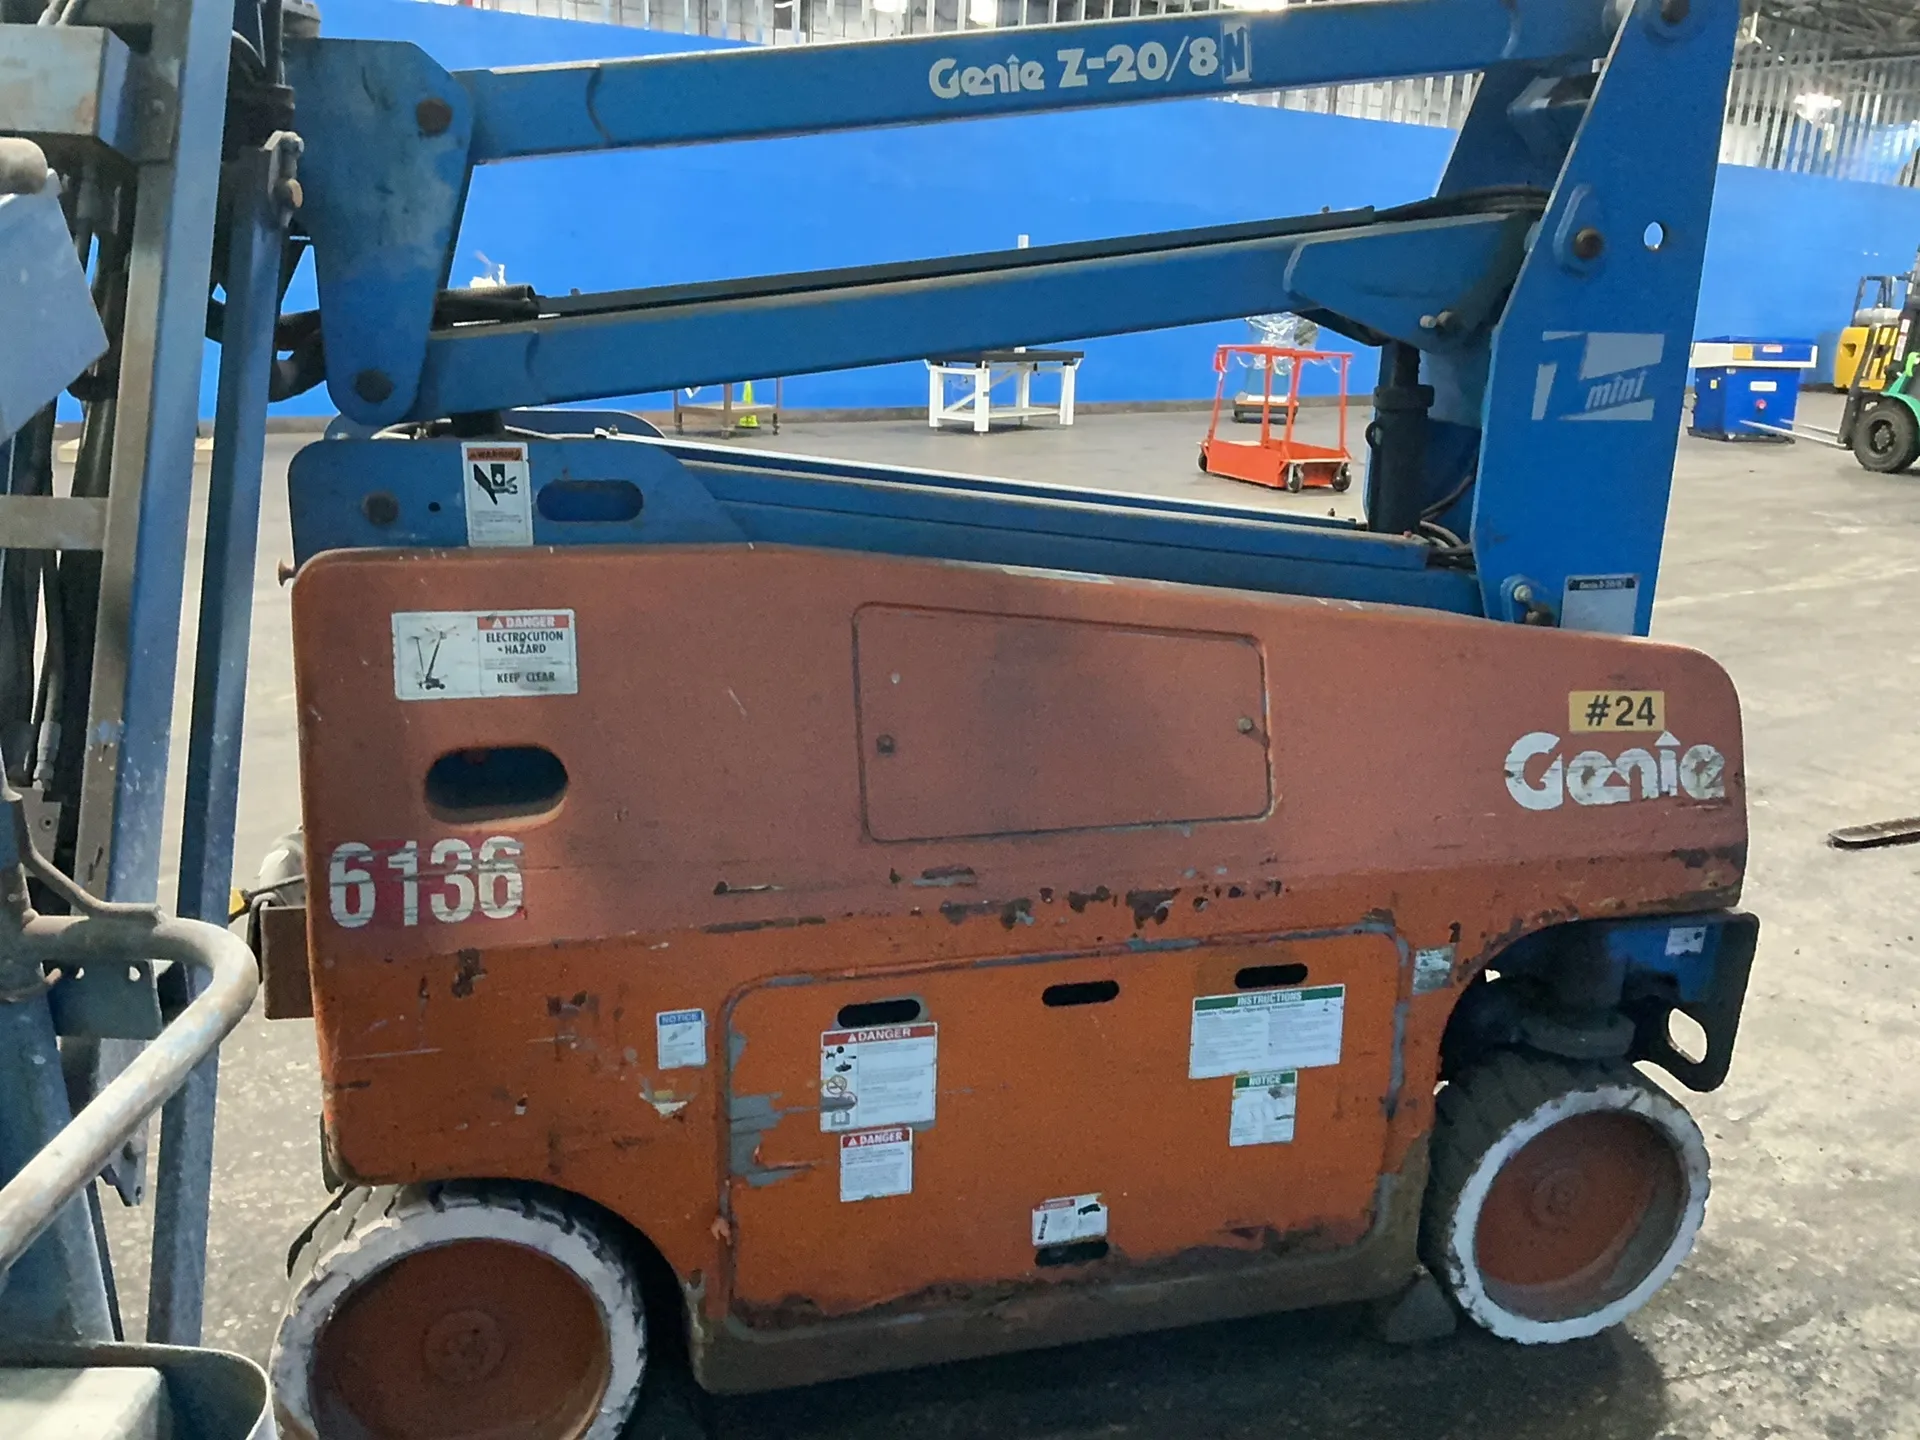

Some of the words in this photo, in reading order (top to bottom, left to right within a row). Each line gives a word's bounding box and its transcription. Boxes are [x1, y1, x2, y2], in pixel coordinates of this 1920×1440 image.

[929, 54, 1045, 99] Genie
[1585, 370, 1648, 410] mini
[506, 616, 555, 628] DANGER
[486, 631, 563, 643] ELECTROCUTION
[504, 643, 547, 654] HAZARD
[497, 672, 520, 683] KEEP
[526, 671, 556, 682] CLEAR
[1585, 694, 1656, 726] #24
[1504, 730, 1725, 810] Genie
[329, 836, 524, 928] 6136
[1237, 991, 1302, 1006] INSTRUCTIONS
[662, 1013, 699, 1025] NOTICE
[858, 1027, 912, 1042] DANGER
[1249, 1074, 1281, 1086] NOTICE
[860, 1131, 903, 1146] DANGER
